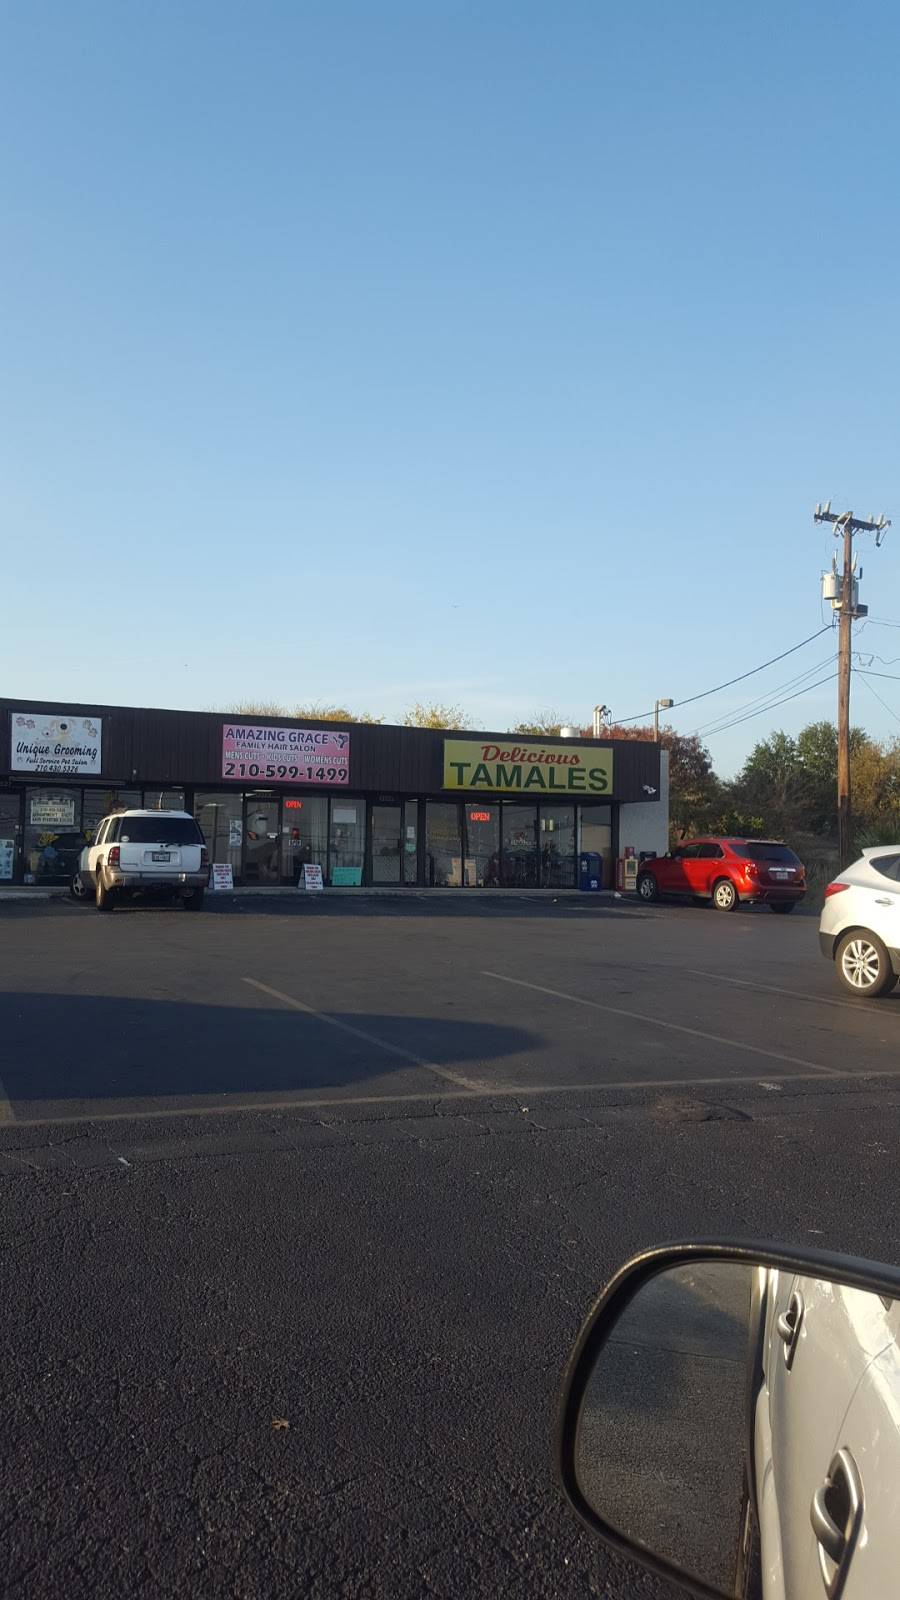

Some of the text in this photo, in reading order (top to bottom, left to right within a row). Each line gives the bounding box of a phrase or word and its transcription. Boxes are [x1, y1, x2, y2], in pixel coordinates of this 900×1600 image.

[225, 728, 329, 744] AMAZING GRACE
[16, 742, 98, 760] Unique Grooming
[236, 742, 316, 752] FAMILY HAIR SALON
[481, 744, 581, 765] Delicious
[224, 763, 348, 781] 210-599-1499
[450, 762, 608, 791] TAMALES
[284, 800, 304, 808] OPEN
[470, 812, 490, 821] OPEN
